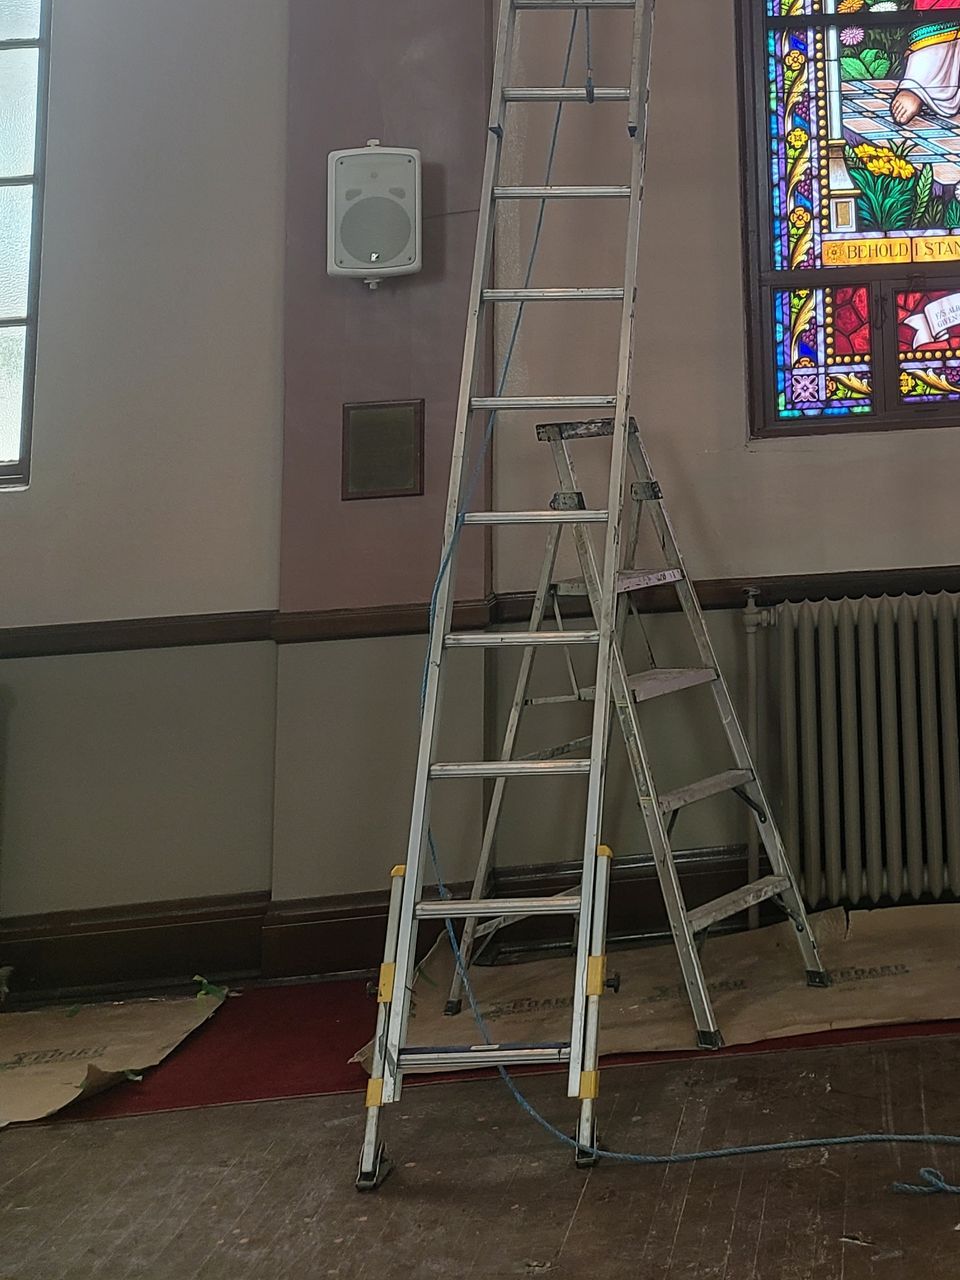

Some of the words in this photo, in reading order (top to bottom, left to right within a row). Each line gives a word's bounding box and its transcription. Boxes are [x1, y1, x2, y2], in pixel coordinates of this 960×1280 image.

[847, 243, 909, 259] BEHOLD
[914, 243, 919, 256] I
[938, 316, 958, 327] GIVEN
